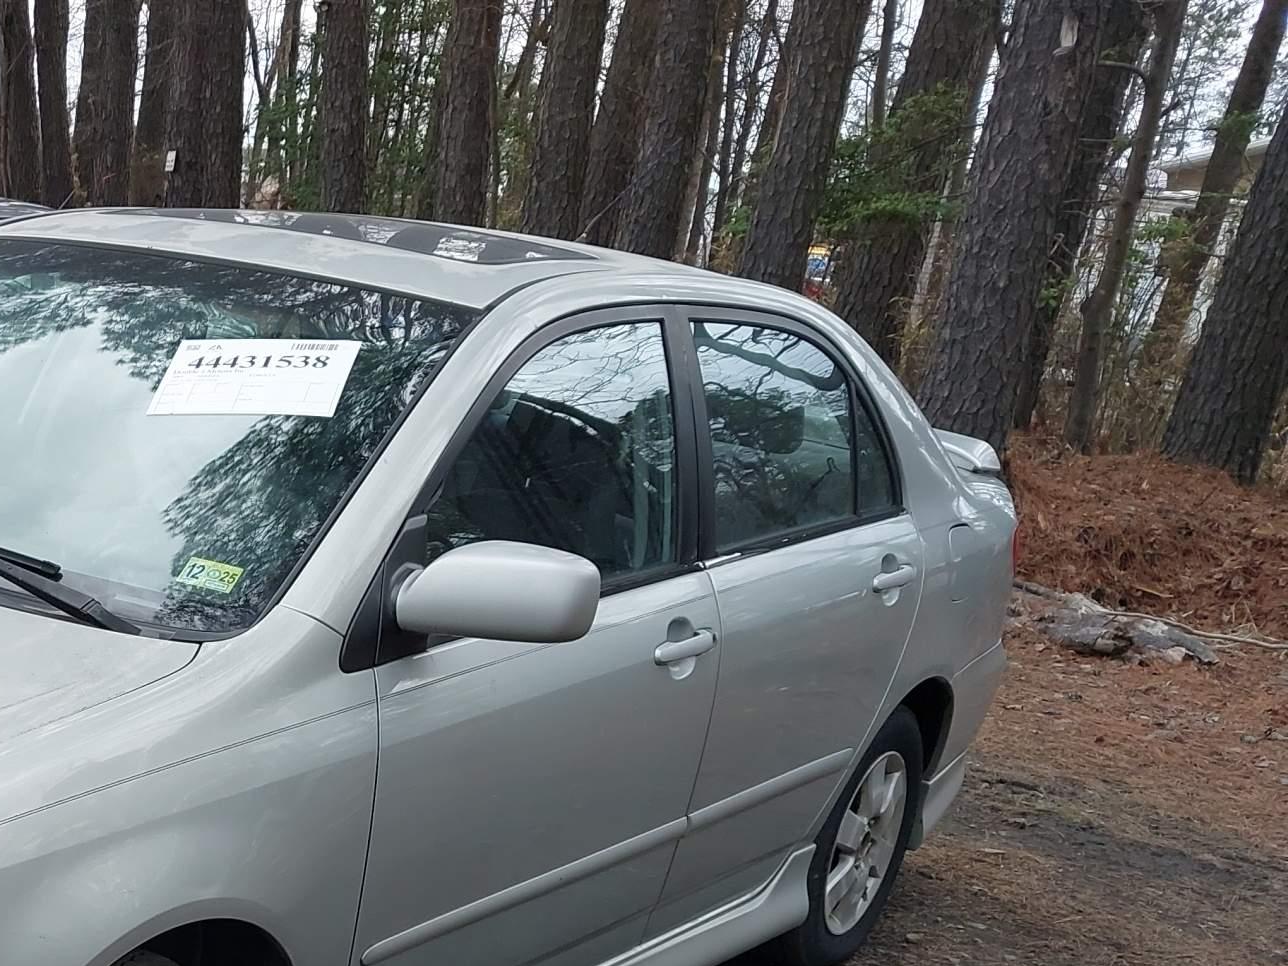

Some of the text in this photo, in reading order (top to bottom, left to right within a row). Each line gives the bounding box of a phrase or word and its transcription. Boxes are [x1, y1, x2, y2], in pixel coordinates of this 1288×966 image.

[187, 355, 331, 369] 44431538
[187, 563, 238, 584] 12 25
